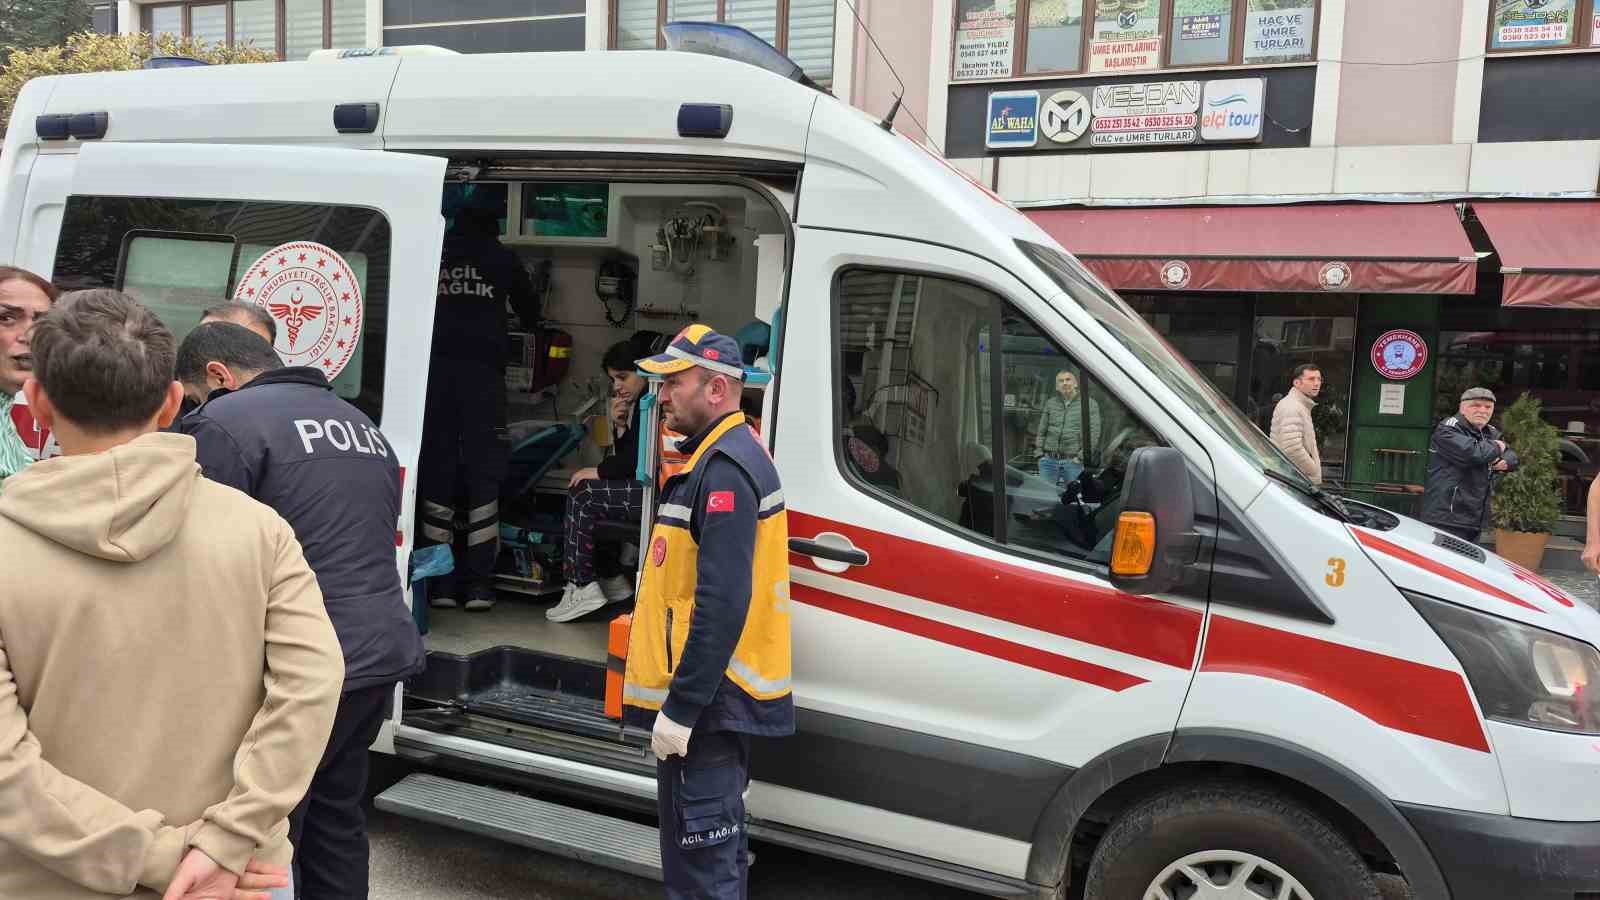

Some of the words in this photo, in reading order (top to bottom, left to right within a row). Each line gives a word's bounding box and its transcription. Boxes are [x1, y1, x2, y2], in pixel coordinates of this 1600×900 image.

[1258, 16, 1283, 25] HAC
[1285, 15, 1303, 24] VE
[1262, 26, 1297, 37] UMRE
[1092, 44, 1110, 55] UMRE
[1112, 41, 1158, 53] KAYITLARIMIZ
[1254, 38, 1304, 49] TURLARI
[1104, 56, 1147, 67] BAŞLAMIŞTIR
[1096, 82, 1198, 109] MEYDAN
[991, 117, 1004, 129] AL
[1007, 116, 1034, 129] WAHA
[1095, 118, 1111, 130] 0532
[1131, 117, 1140, 128] 42
[1144, 116, 1161, 127] 0530
[1174, 115, 1183, 126] 54
[1184, 114, 1193, 125] 30
[1201, 110, 1228, 130] elçi
[1229, 112, 1259, 127] tour
[1095, 133, 1114, 143] HAC
[1114, 134, 1124, 142] ve
[1126, 132, 1151, 142] UMRE
[257, 270, 308, 306] UMHURİYETİ
[438, 280, 495, 298] AĞLIK
[294, 419, 388, 458] POLİS
[1325, 557, 1346, 588] 3
